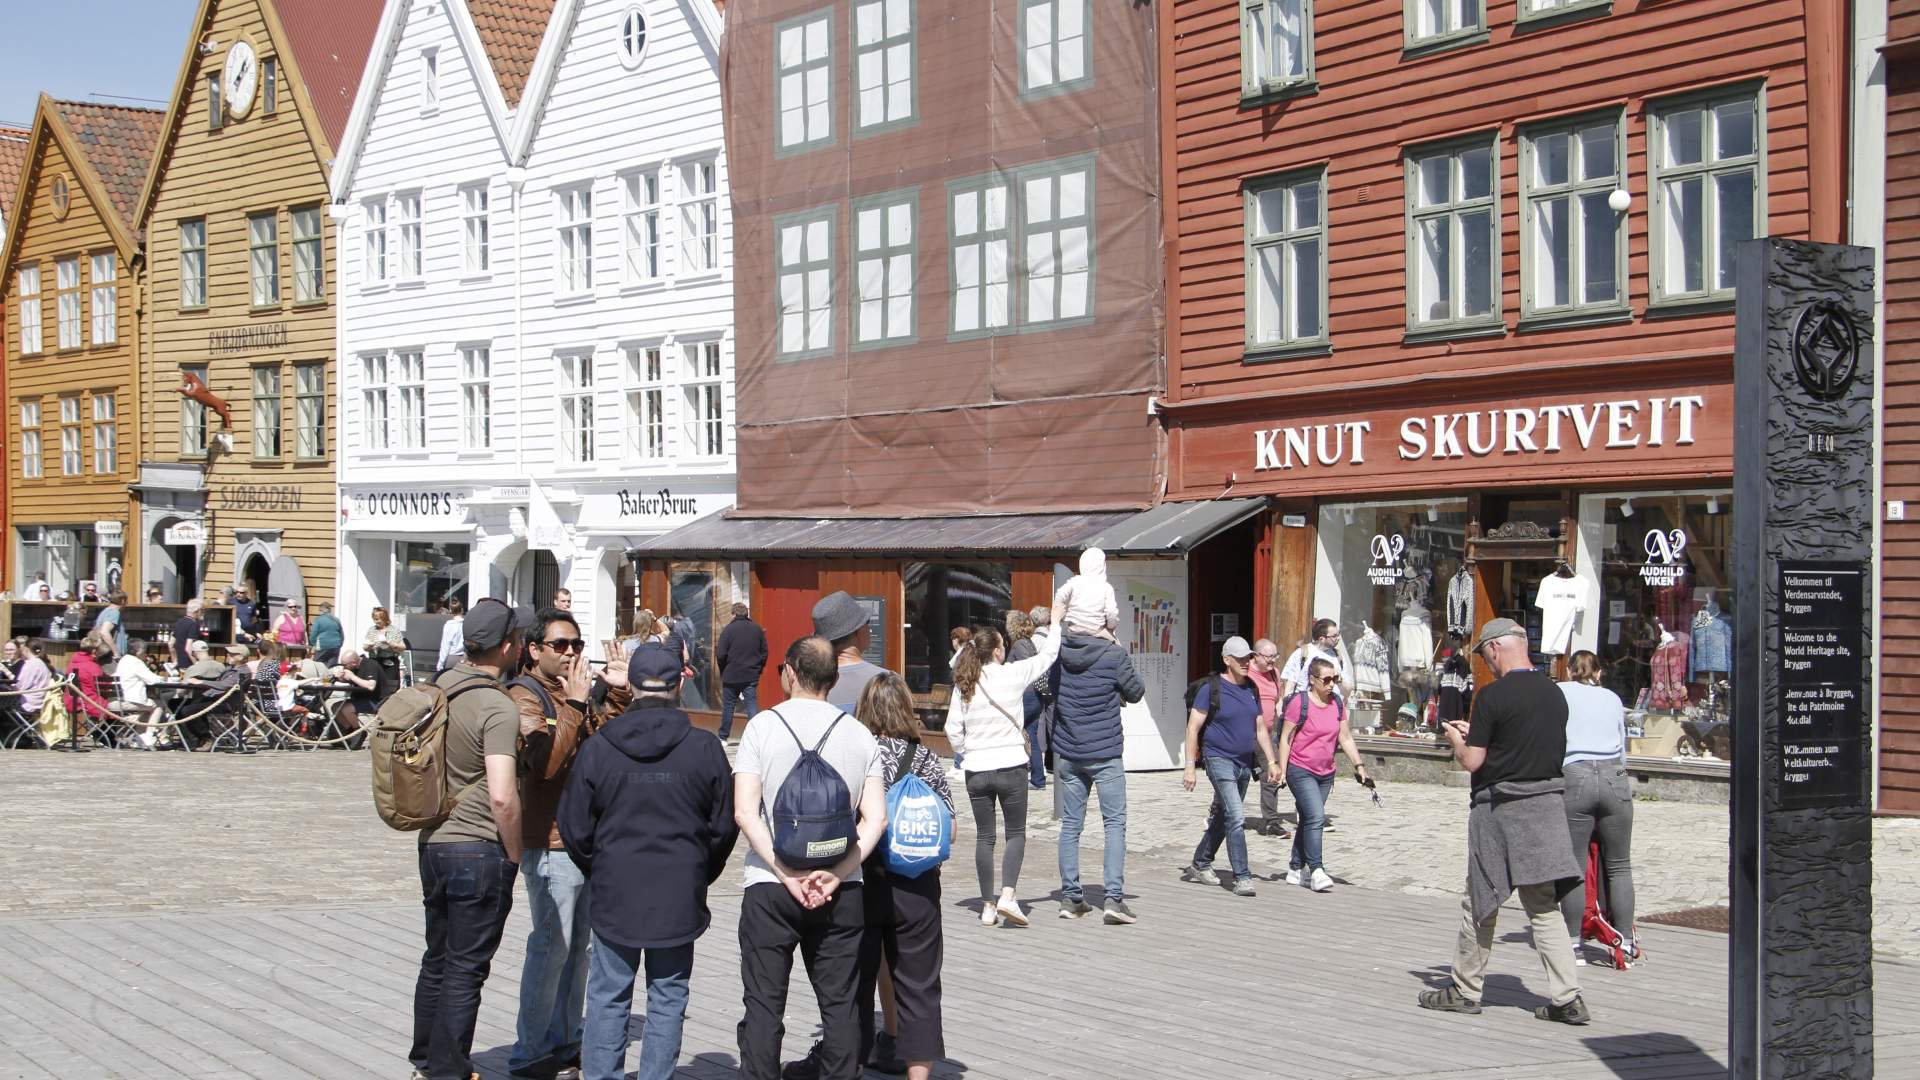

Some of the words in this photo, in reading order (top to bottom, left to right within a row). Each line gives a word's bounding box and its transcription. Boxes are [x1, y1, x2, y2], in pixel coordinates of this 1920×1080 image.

[1253, 420, 1371, 472] KNUT
[1398, 395, 1704, 460] SKURTVEIT
[221, 485, 302, 510] SJØBODEN
[368, 492, 451, 515] O'CONNOR'S
[1367, 568, 1403, 577] AUDHILD
[1639, 566, 1684, 577] AUDHILD
[1371, 577, 1396, 586] VIKEN
[1644, 576, 1675, 586] VIKEN
[1784, 576, 1823, 586] Velkommen
[1825, 576, 1833, 586] til
[1784, 589, 1843, 601] Verdensarvstedet,
[1784, 602, 1812, 614] Bryggen
[1784, 632, 1815, 642] Welcome
[1816, 634, 1824, 642] to
[1826, 632, 1837, 642] the
[1784, 645, 1804, 656] World
[1807, 645, 1835, 656] Heritage
[1837, 645, 1850, 656] site,
[1784, 658, 1811, 670] Bryggen
[1819, 688, 1824, 698] à
[1825, 688, 1854, 699] Bryggen,
[1786, 702, 1797, 712] ite
[1799, 702, 1808, 712] du
[1809, 701, 1845, 711] Patrimoine
[1783, 757, 1833, 768] Weltkulturerb
[899, 820, 938, 836] BIKE
[904, 835, 932, 844] Libraries
